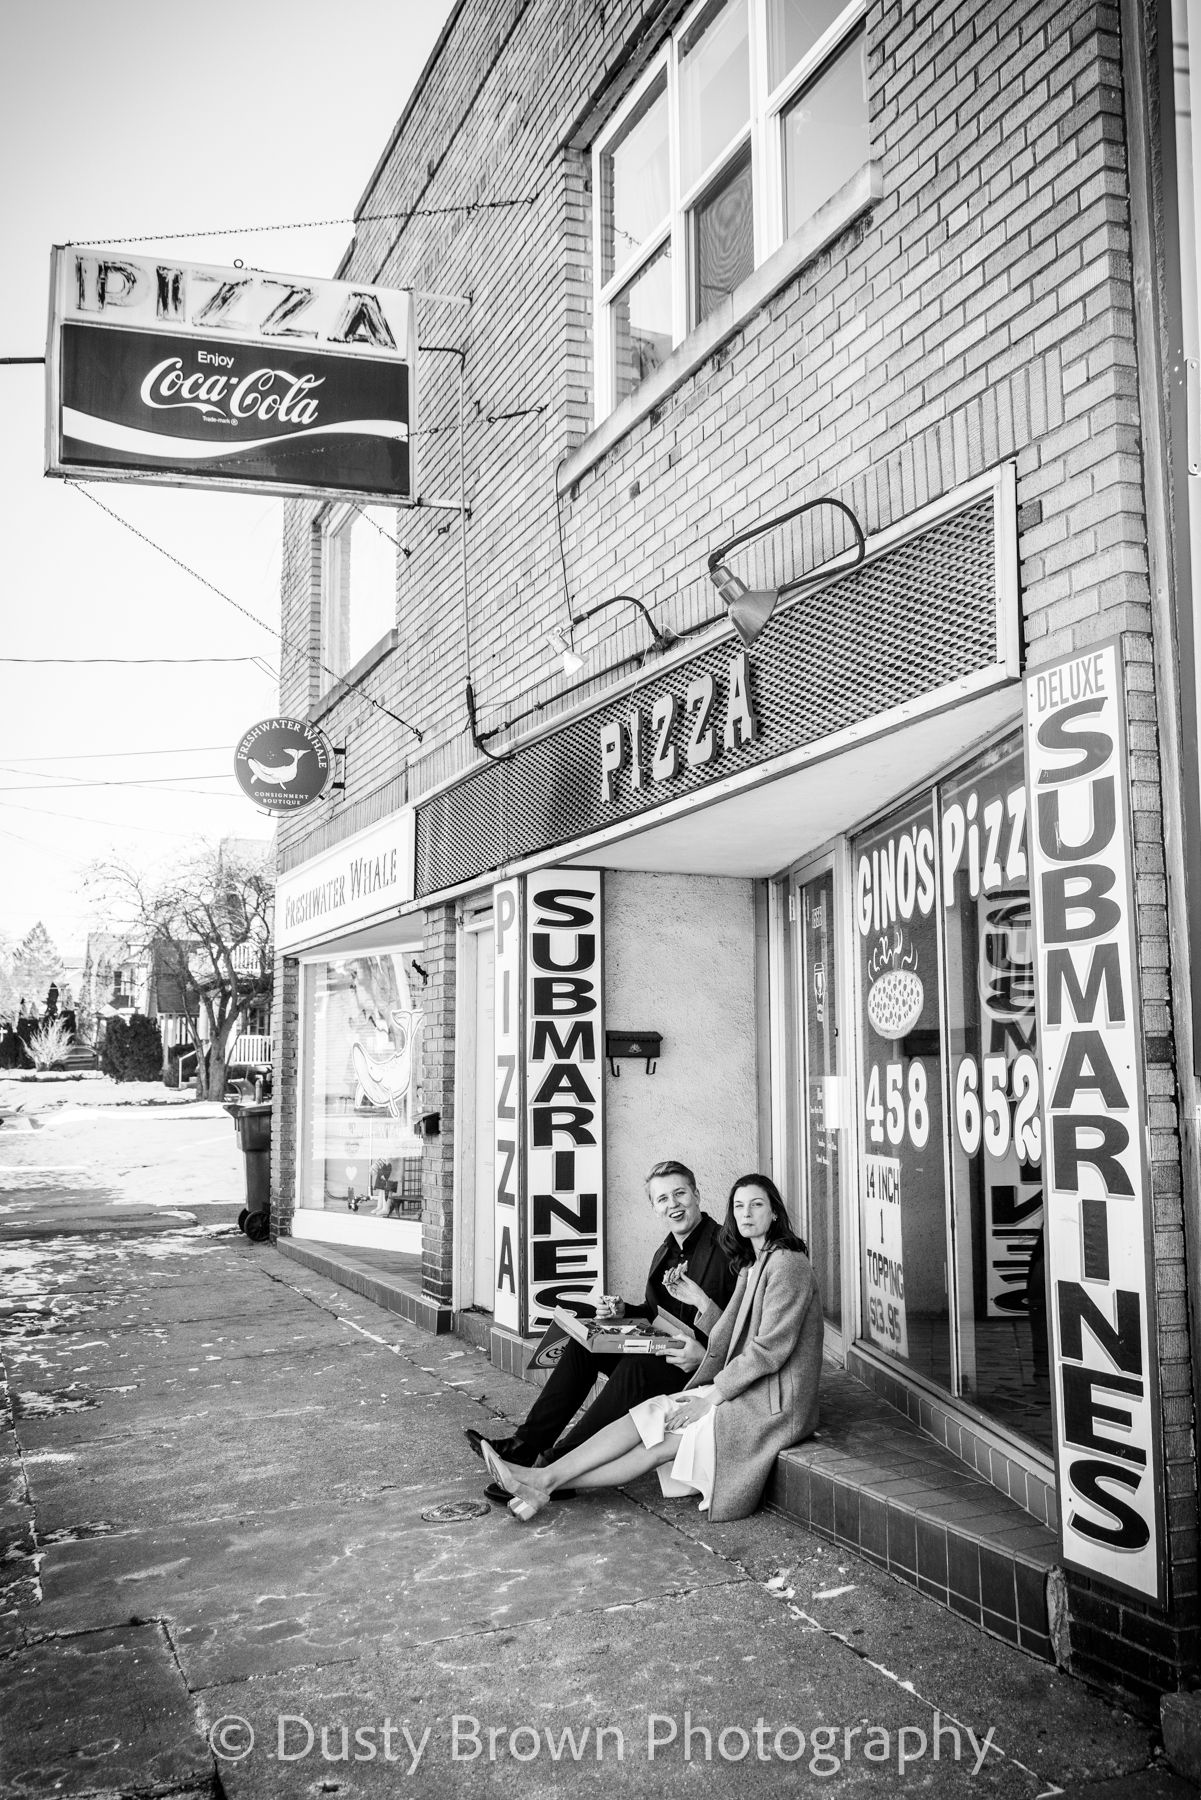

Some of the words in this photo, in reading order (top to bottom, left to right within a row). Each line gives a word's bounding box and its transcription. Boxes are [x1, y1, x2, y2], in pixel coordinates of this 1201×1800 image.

[75, 254, 398, 350] PIZZA
[140, 357, 326, 425] Coca-Cola
[197, 350, 235, 368] Enjoy
[1037, 653, 1105, 713] DELUXE
[237, 719, 301, 761] FRESHWATER
[303, 727, 328, 769] WHALE
[600, 651, 756, 802] PIZZA
[254, 791, 309, 800] CONSIGNMENT
[263, 798, 301, 806] BOUTIQUE
[284, 874, 346, 930] FRESHWATER
[349, 848, 397, 901] WHALE
[857, 825, 935, 936] GINO'S
[496, 890, 517, 1297] PIZZA
[530, 888, 599, 1328] SUBMARINES
[865, 1061, 930, 1149] 458
[1037, 697, 1151, 1552] SUBMARINES
[878, 1165, 900, 1205] INCH
[866, 1248, 904, 1301] TOPPING
